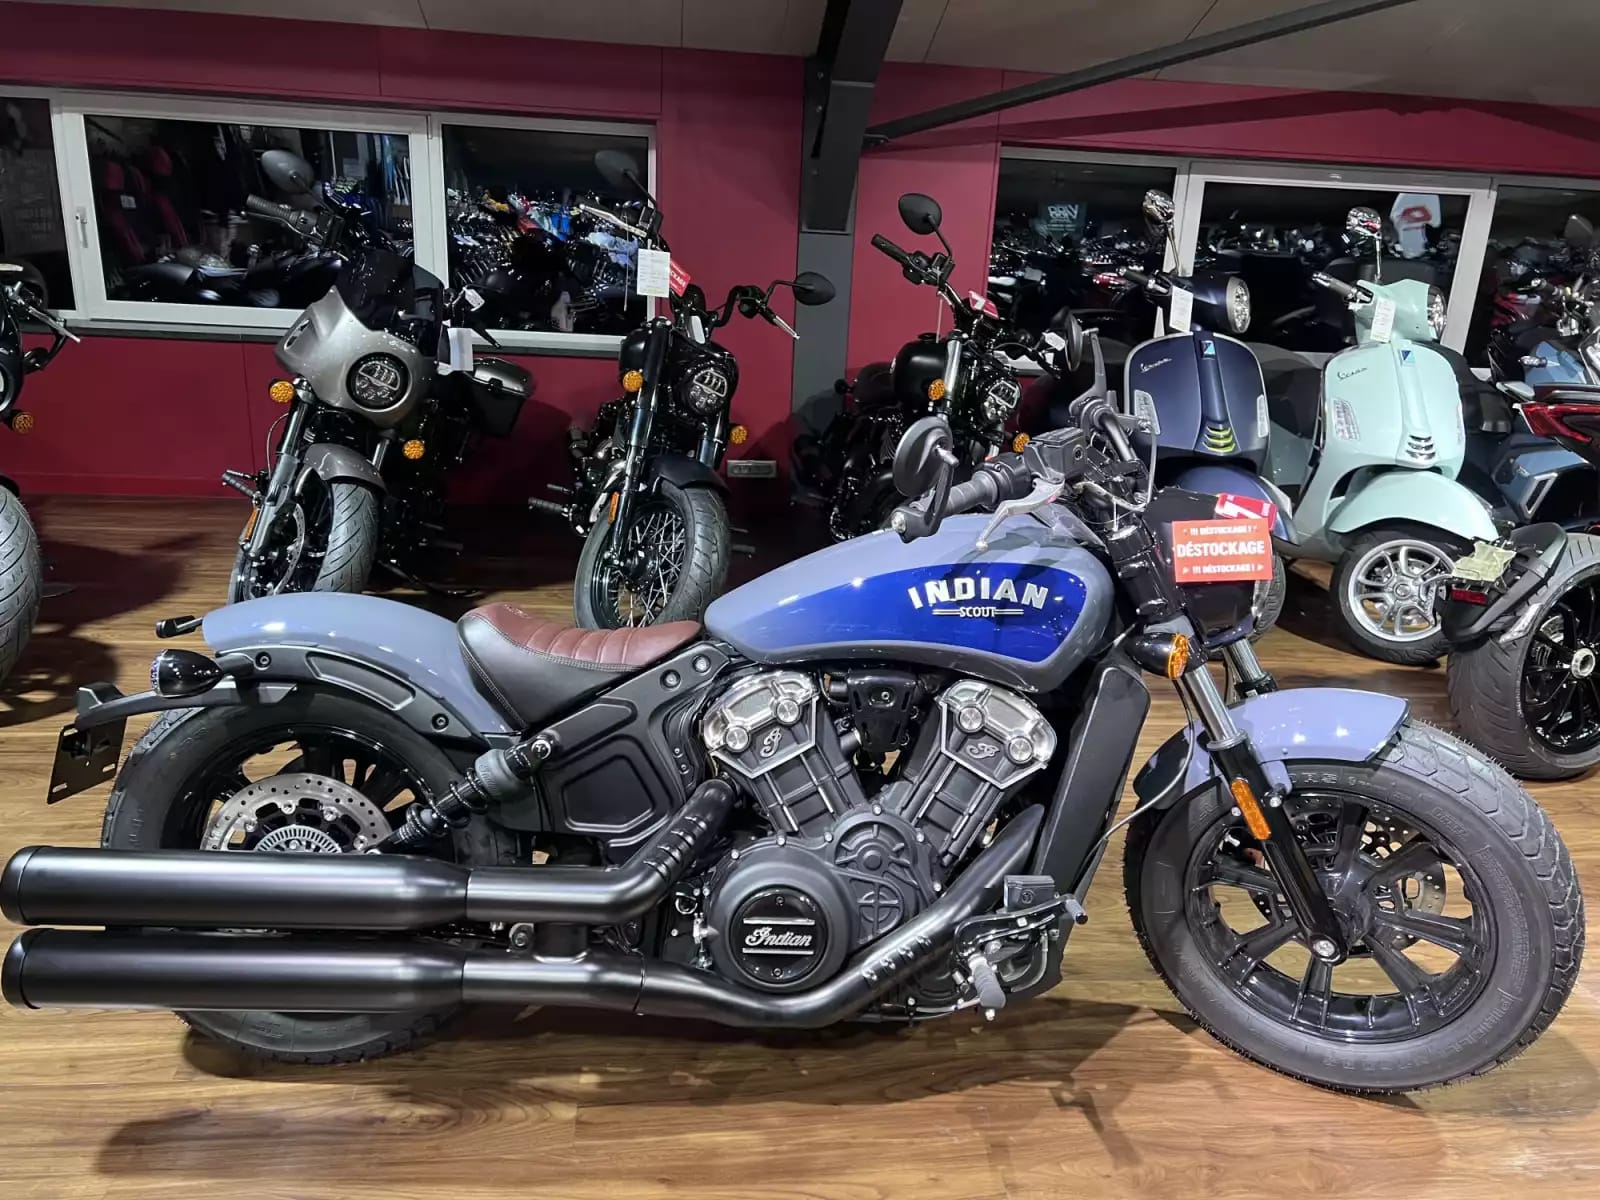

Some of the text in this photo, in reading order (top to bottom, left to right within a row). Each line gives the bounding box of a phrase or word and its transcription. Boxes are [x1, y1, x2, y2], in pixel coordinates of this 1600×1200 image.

[1176, 540, 1265, 558] DÉSTOCKAGE
[907, 577, 1049, 610] INDIAN
[959, 606, 997, 618] SCOUT
[744, 926, 812, 947] Indian
